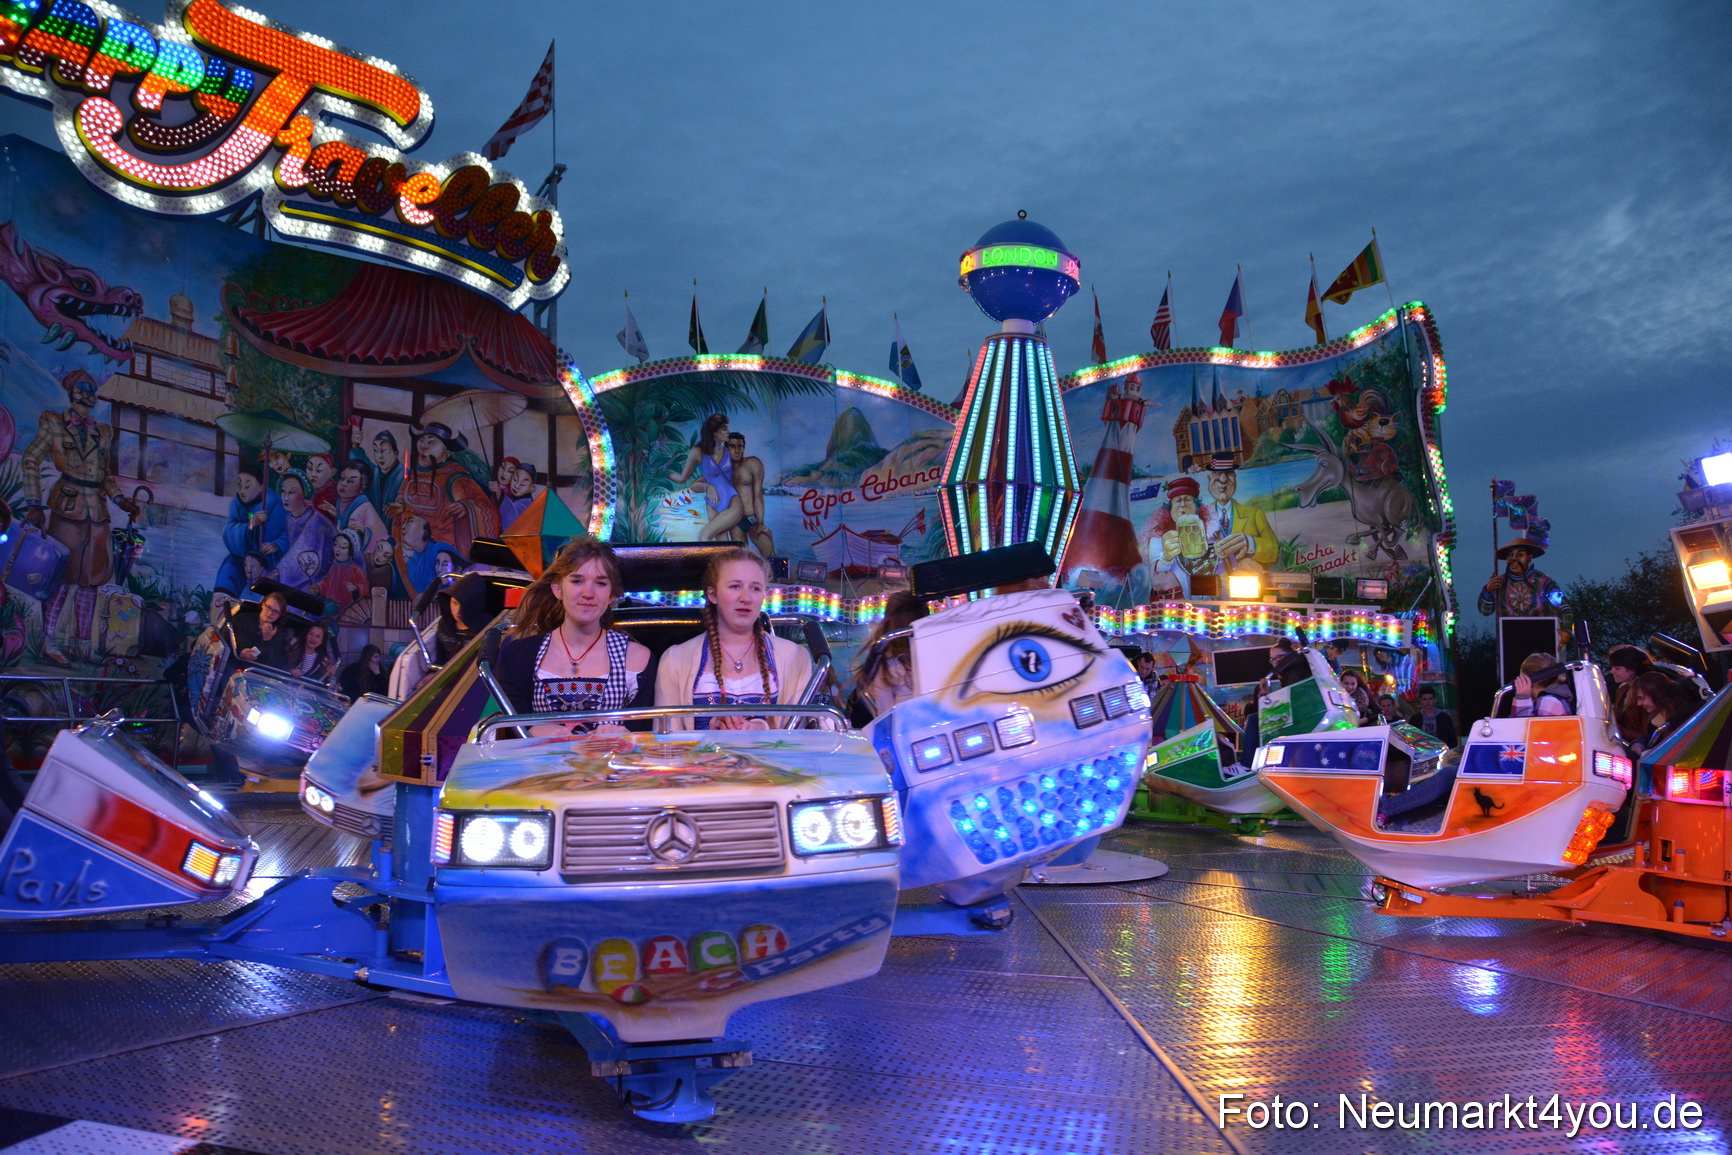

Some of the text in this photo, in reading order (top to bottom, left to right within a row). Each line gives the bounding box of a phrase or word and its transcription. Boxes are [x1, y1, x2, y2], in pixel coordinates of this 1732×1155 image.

[76, 0, 562, 283] Traveller
[982, 247, 1058, 266] LONDON
[799, 466, 941, 519] Copa Cabana
[551, 915, 890, 981] BEACH Party
